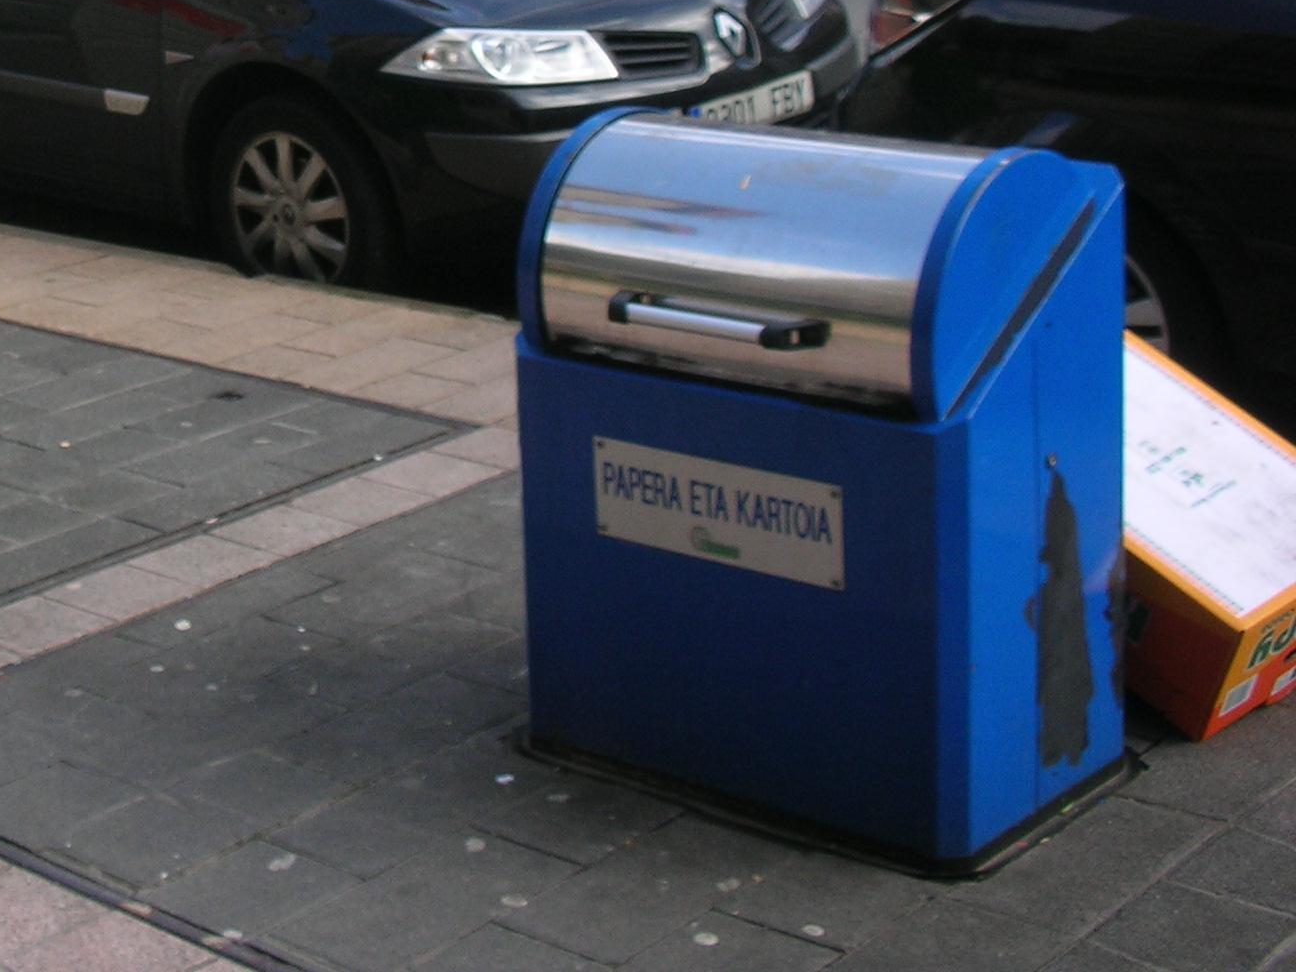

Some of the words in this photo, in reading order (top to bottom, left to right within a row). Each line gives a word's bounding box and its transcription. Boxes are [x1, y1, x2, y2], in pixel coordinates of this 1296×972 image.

[602, 461, 682, 511] PAPERA
[689, 480, 730, 522] ETA
[735, 490, 834, 546] KARTOIA
